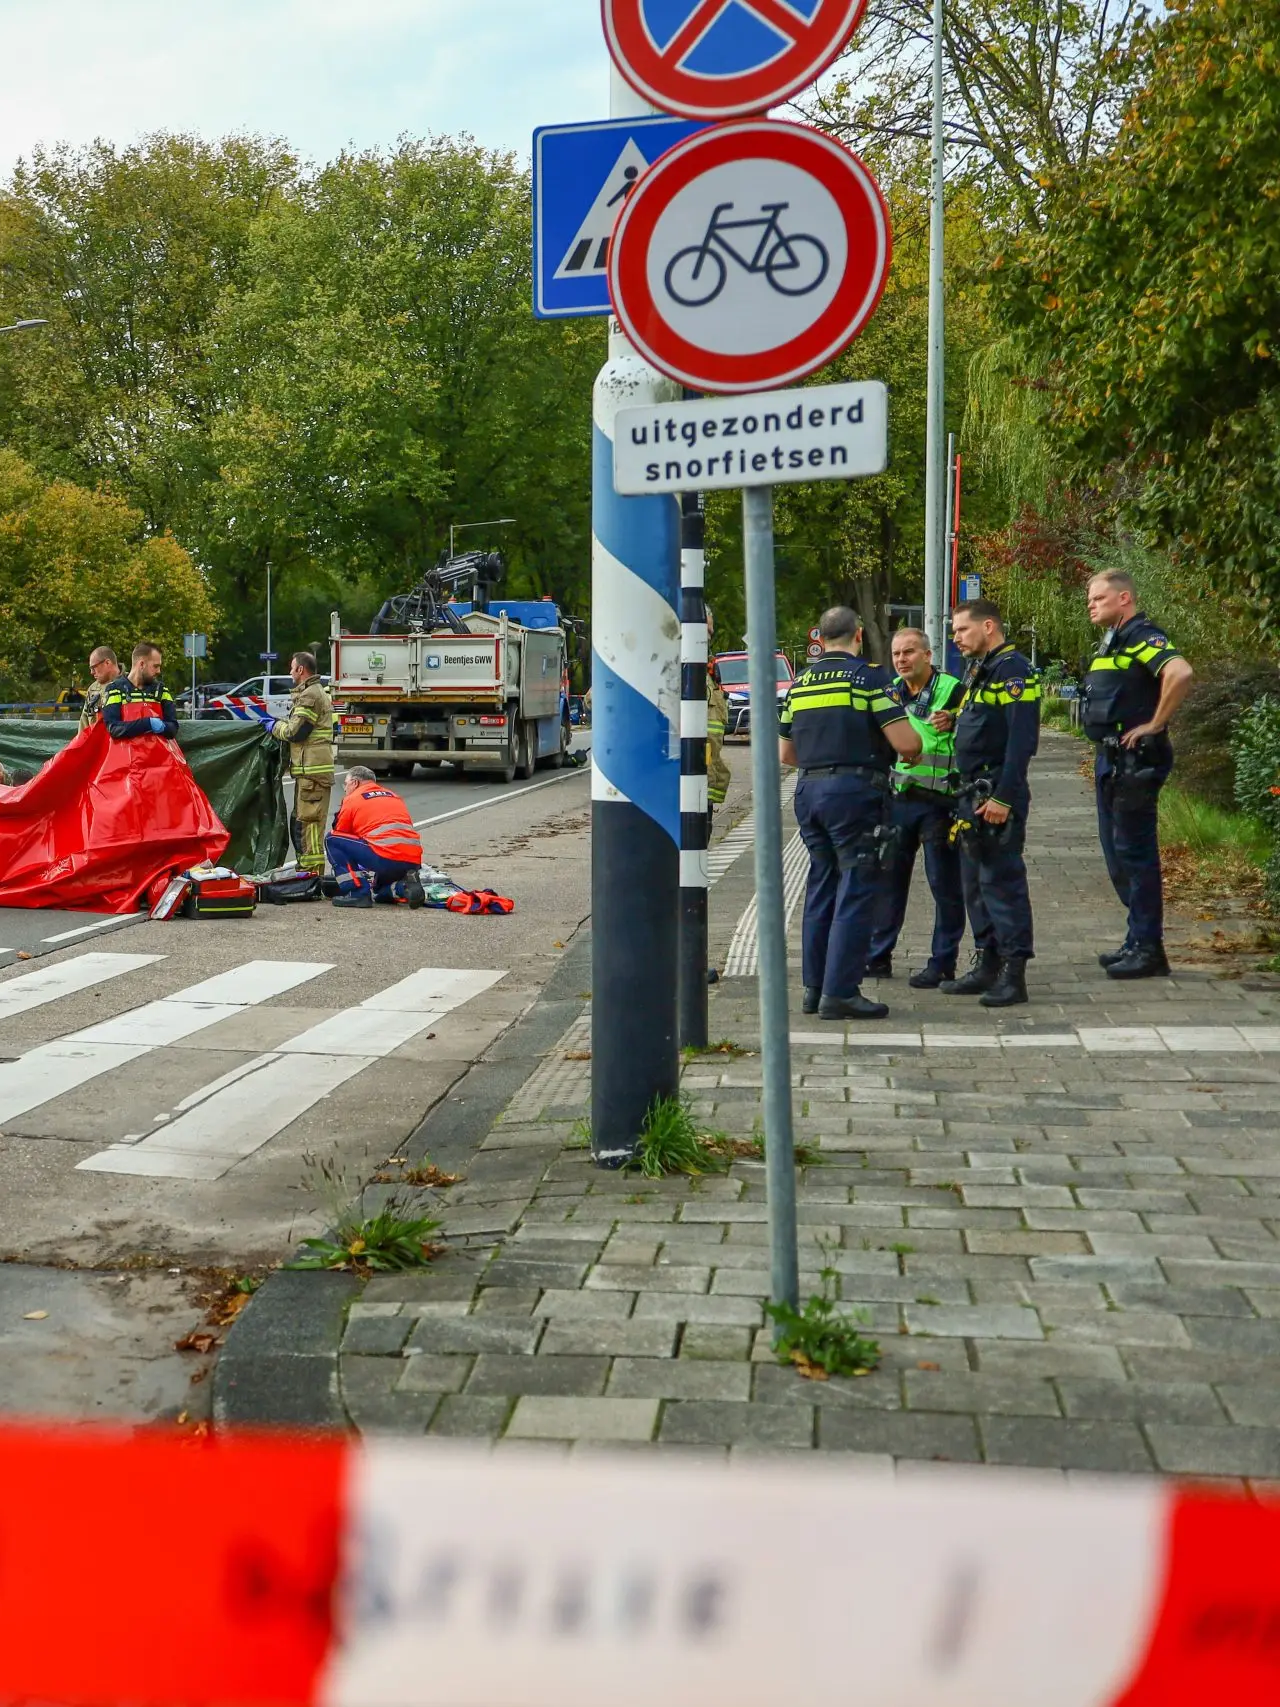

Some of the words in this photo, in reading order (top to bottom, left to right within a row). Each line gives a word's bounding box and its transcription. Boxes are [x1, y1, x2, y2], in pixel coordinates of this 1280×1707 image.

[631, 398, 865, 448] uitgezonderd
[646, 445, 848, 482] snorfietsen
[444, 655, 474, 666] Beentjes
[474, 655, 493, 664] GWW
[794, 670, 844, 685] POLITIE
